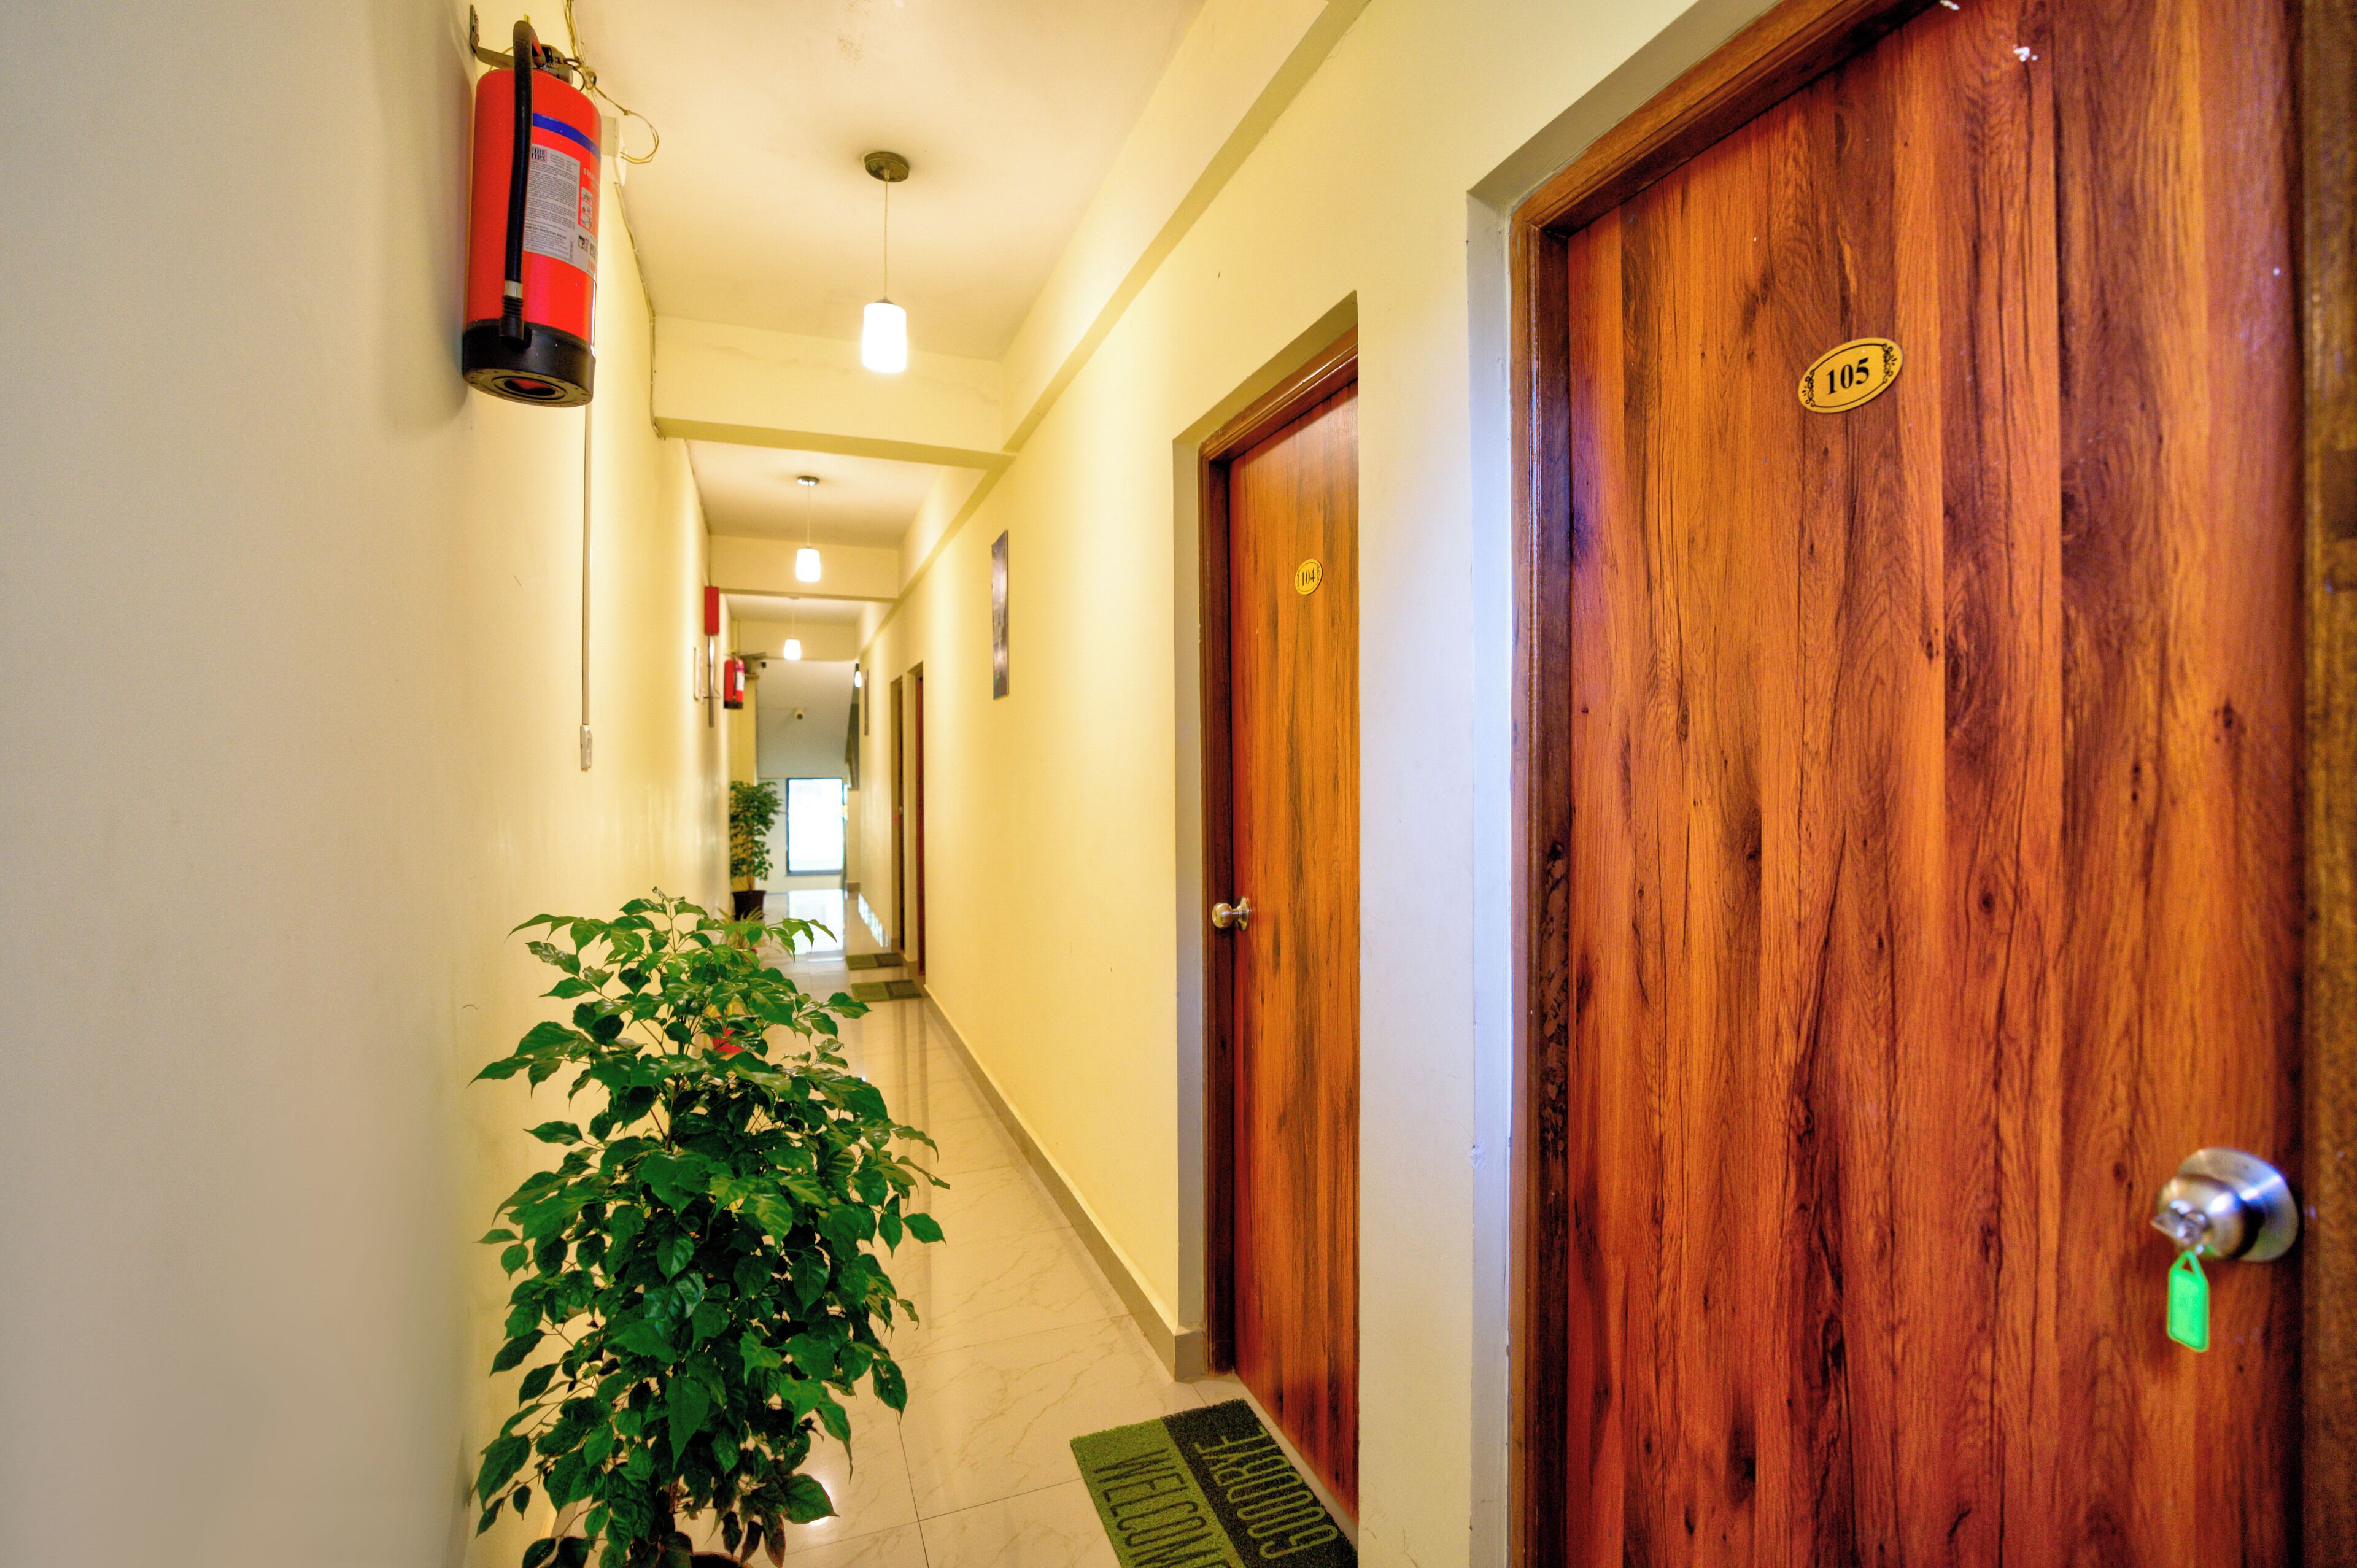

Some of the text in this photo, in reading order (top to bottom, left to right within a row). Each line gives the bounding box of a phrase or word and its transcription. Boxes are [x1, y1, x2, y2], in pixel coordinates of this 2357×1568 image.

[1827, 357, 1870, 395] 105
[1302, 568, 1315, 586] 104
[1194, 1426, 1338, 1559] GOODBYE
